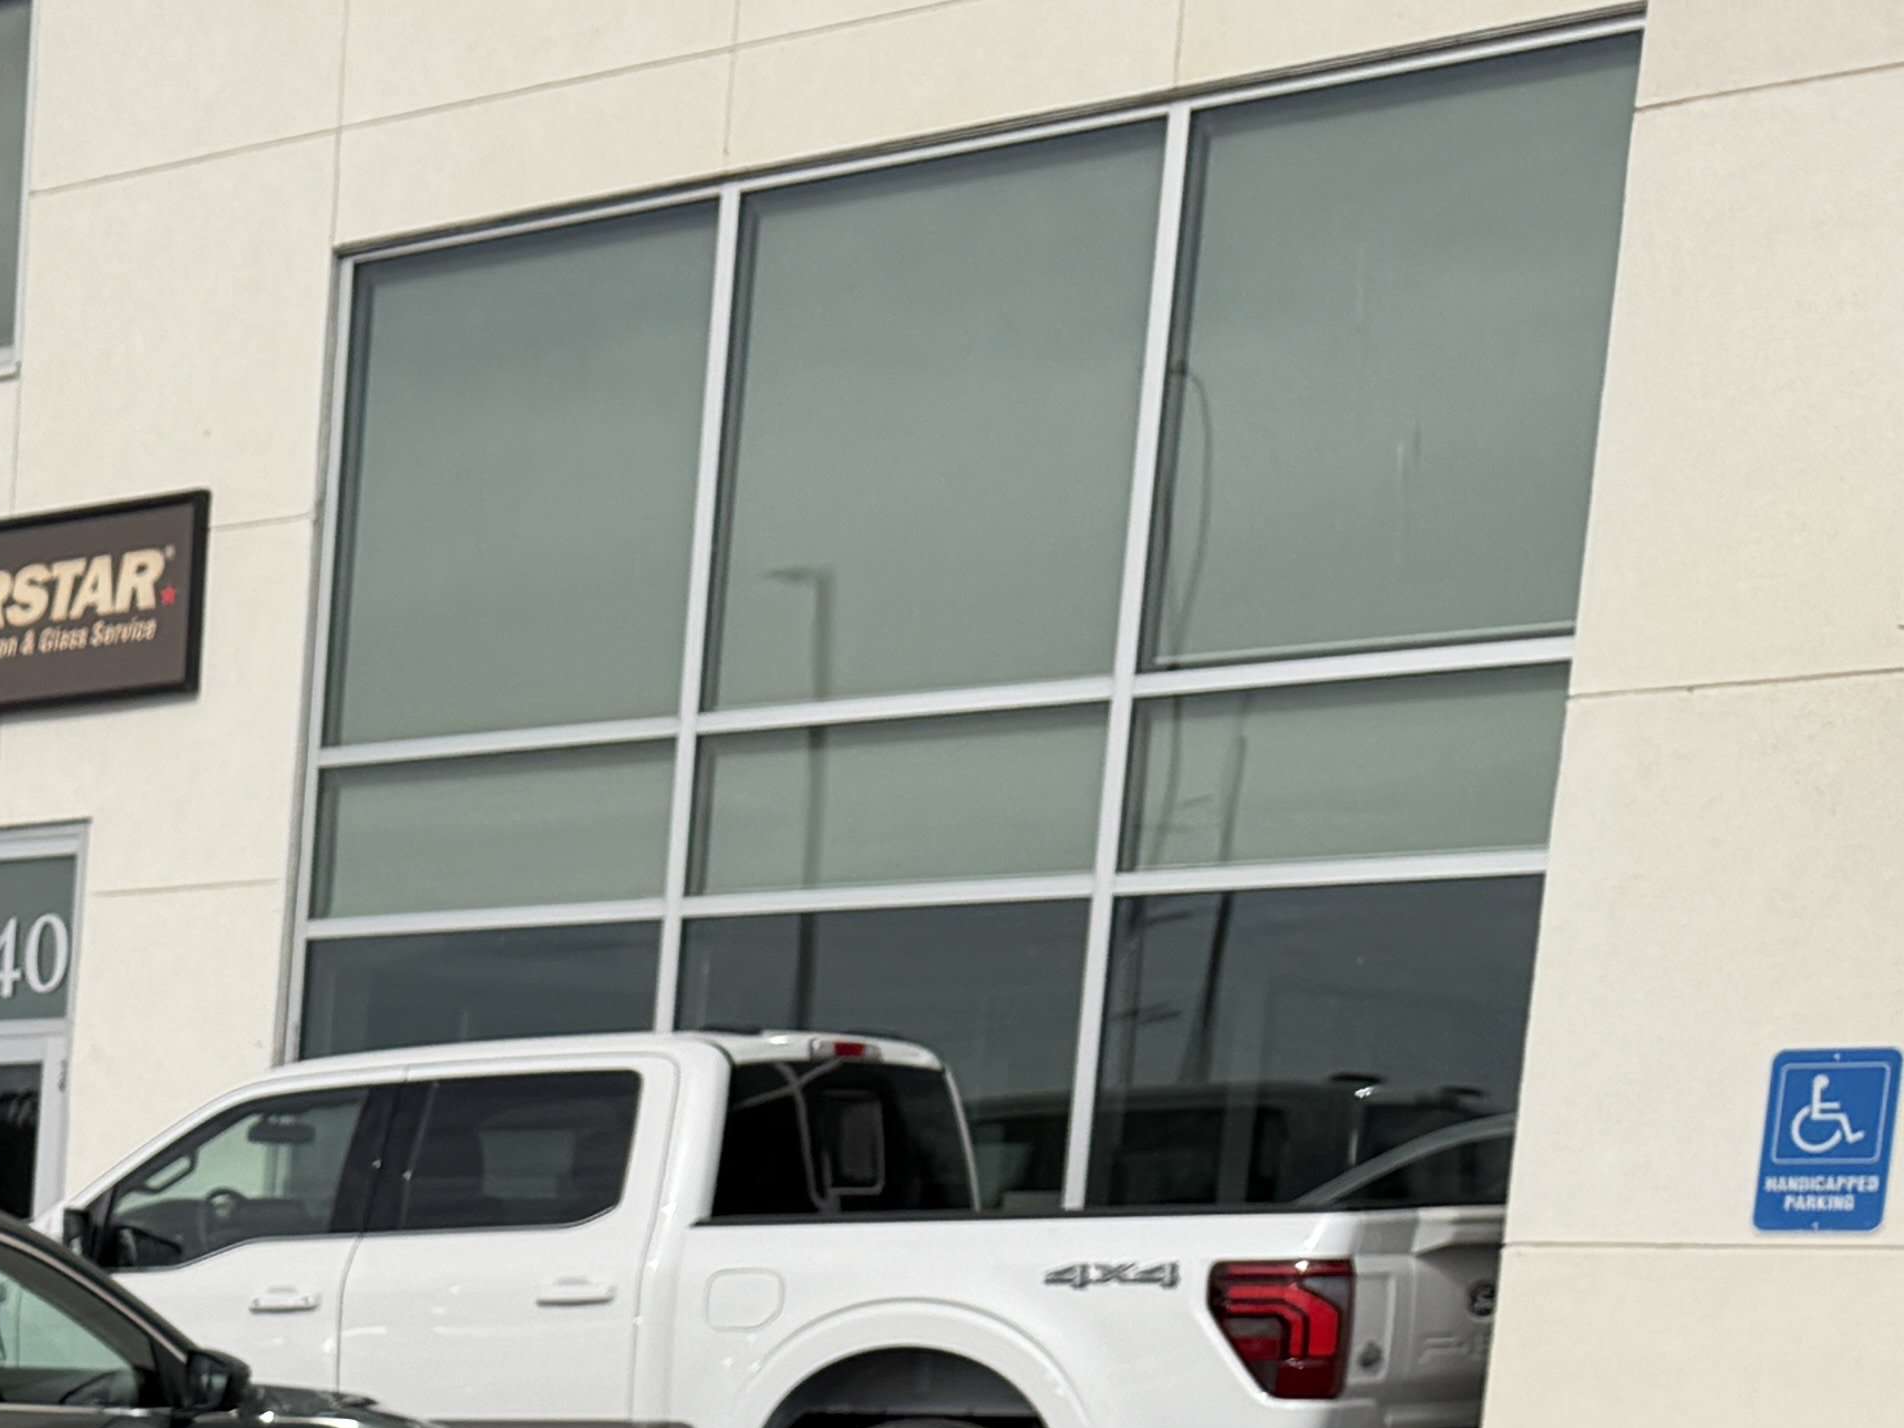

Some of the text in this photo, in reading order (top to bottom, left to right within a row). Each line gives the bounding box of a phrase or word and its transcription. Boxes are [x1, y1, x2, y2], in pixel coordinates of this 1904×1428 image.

[21, 630, 36, 656] &
[39, 625, 87, 653] Glass
[91, 616, 157, 647] Service
[1764, 1174, 1880, 1192] HANDICAPPED
[1783, 1194, 1855, 1212] PARKING
